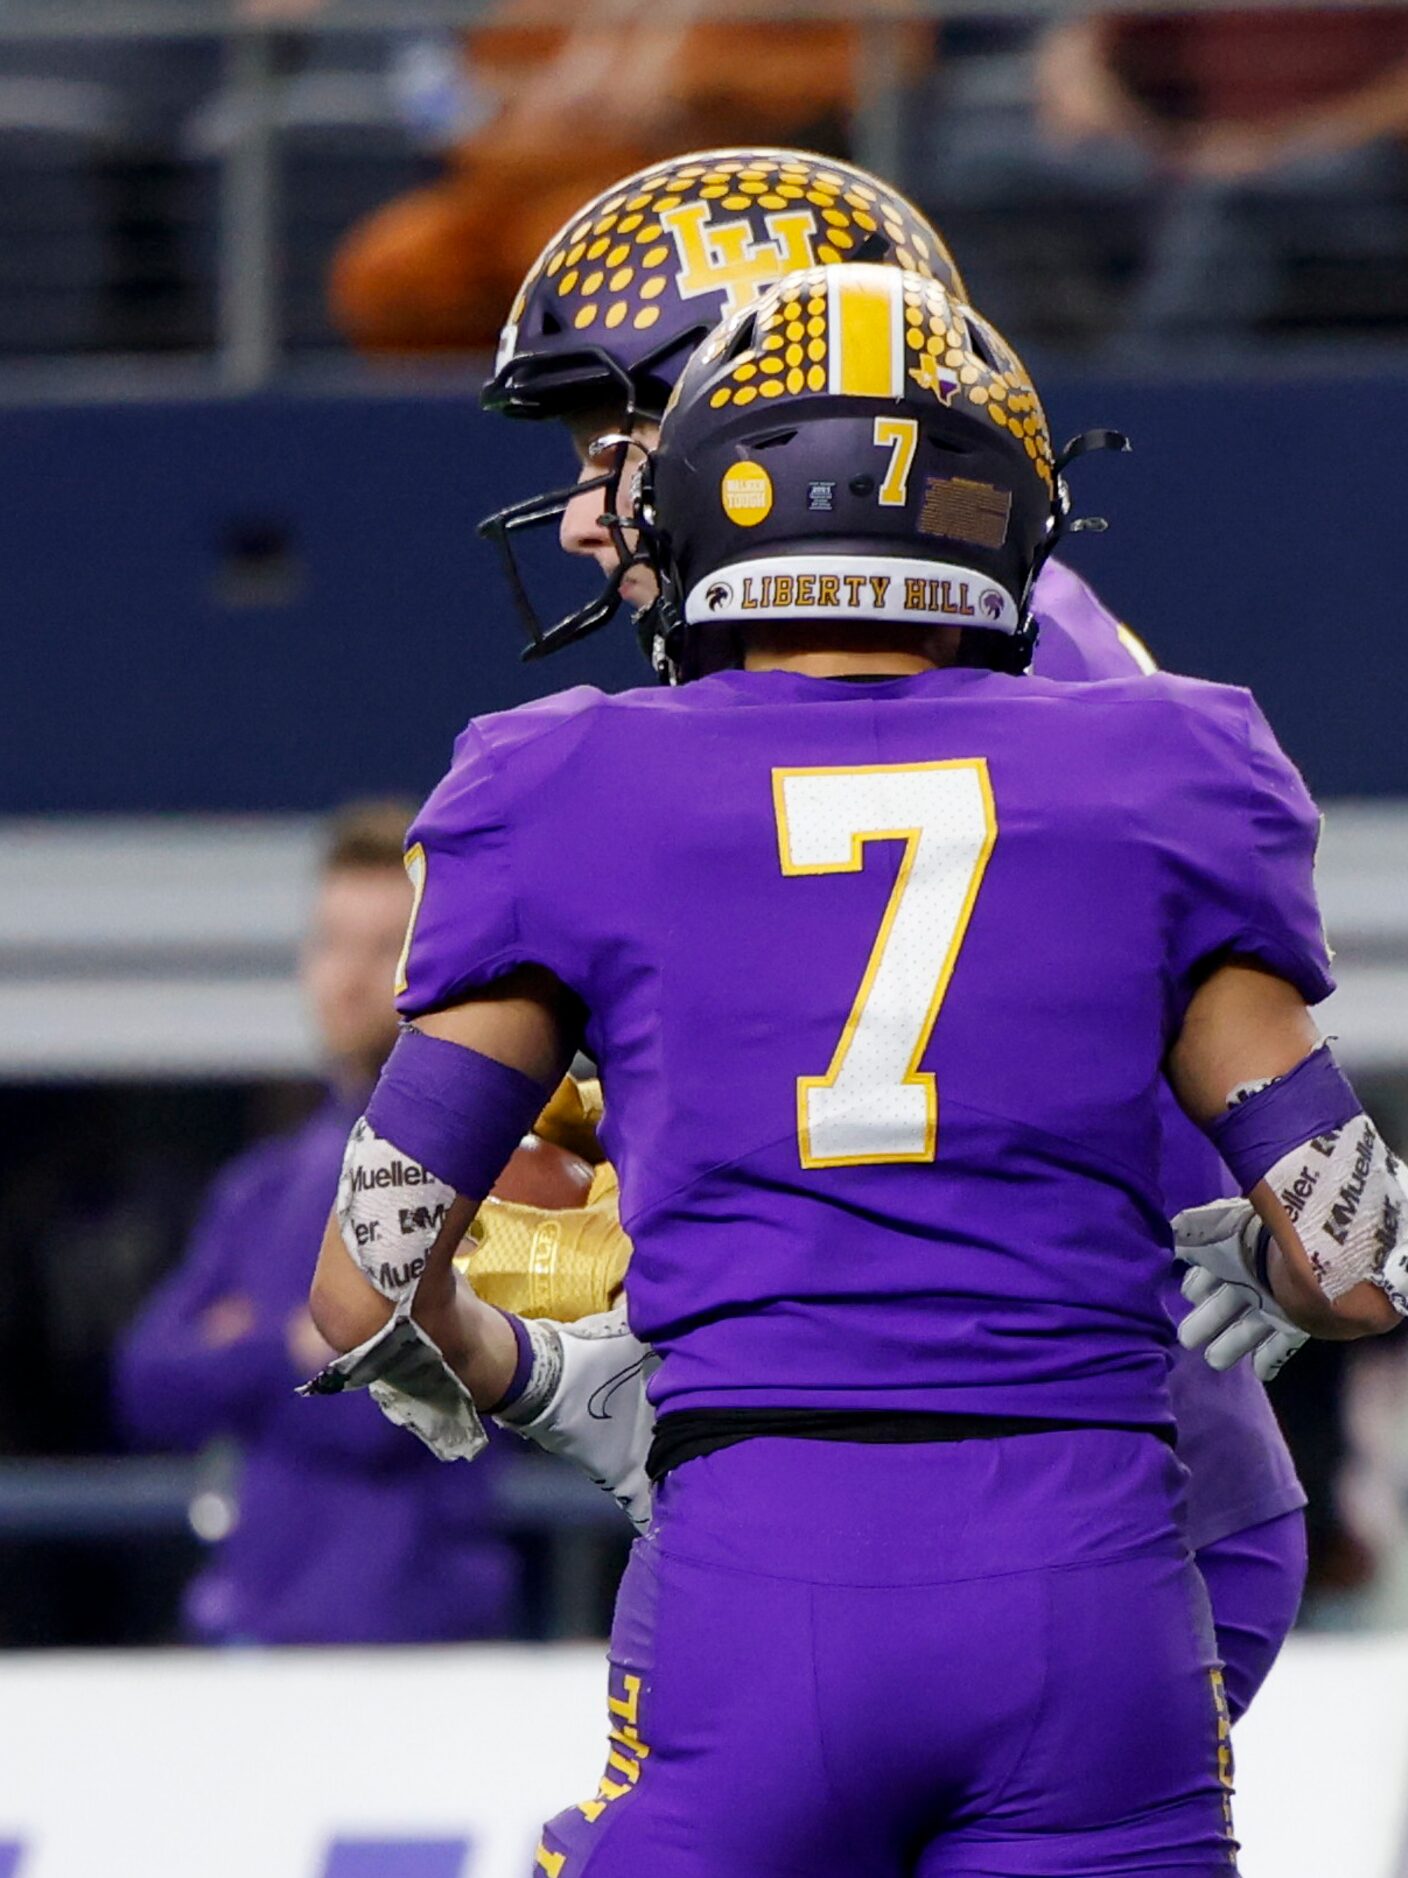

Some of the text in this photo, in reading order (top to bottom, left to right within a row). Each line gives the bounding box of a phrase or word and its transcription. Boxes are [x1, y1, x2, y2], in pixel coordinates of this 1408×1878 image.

[873, 416, 918, 507] 7
[741, 574, 976, 616] LIBERTY HILL
[772, 757, 996, 1169] 7
